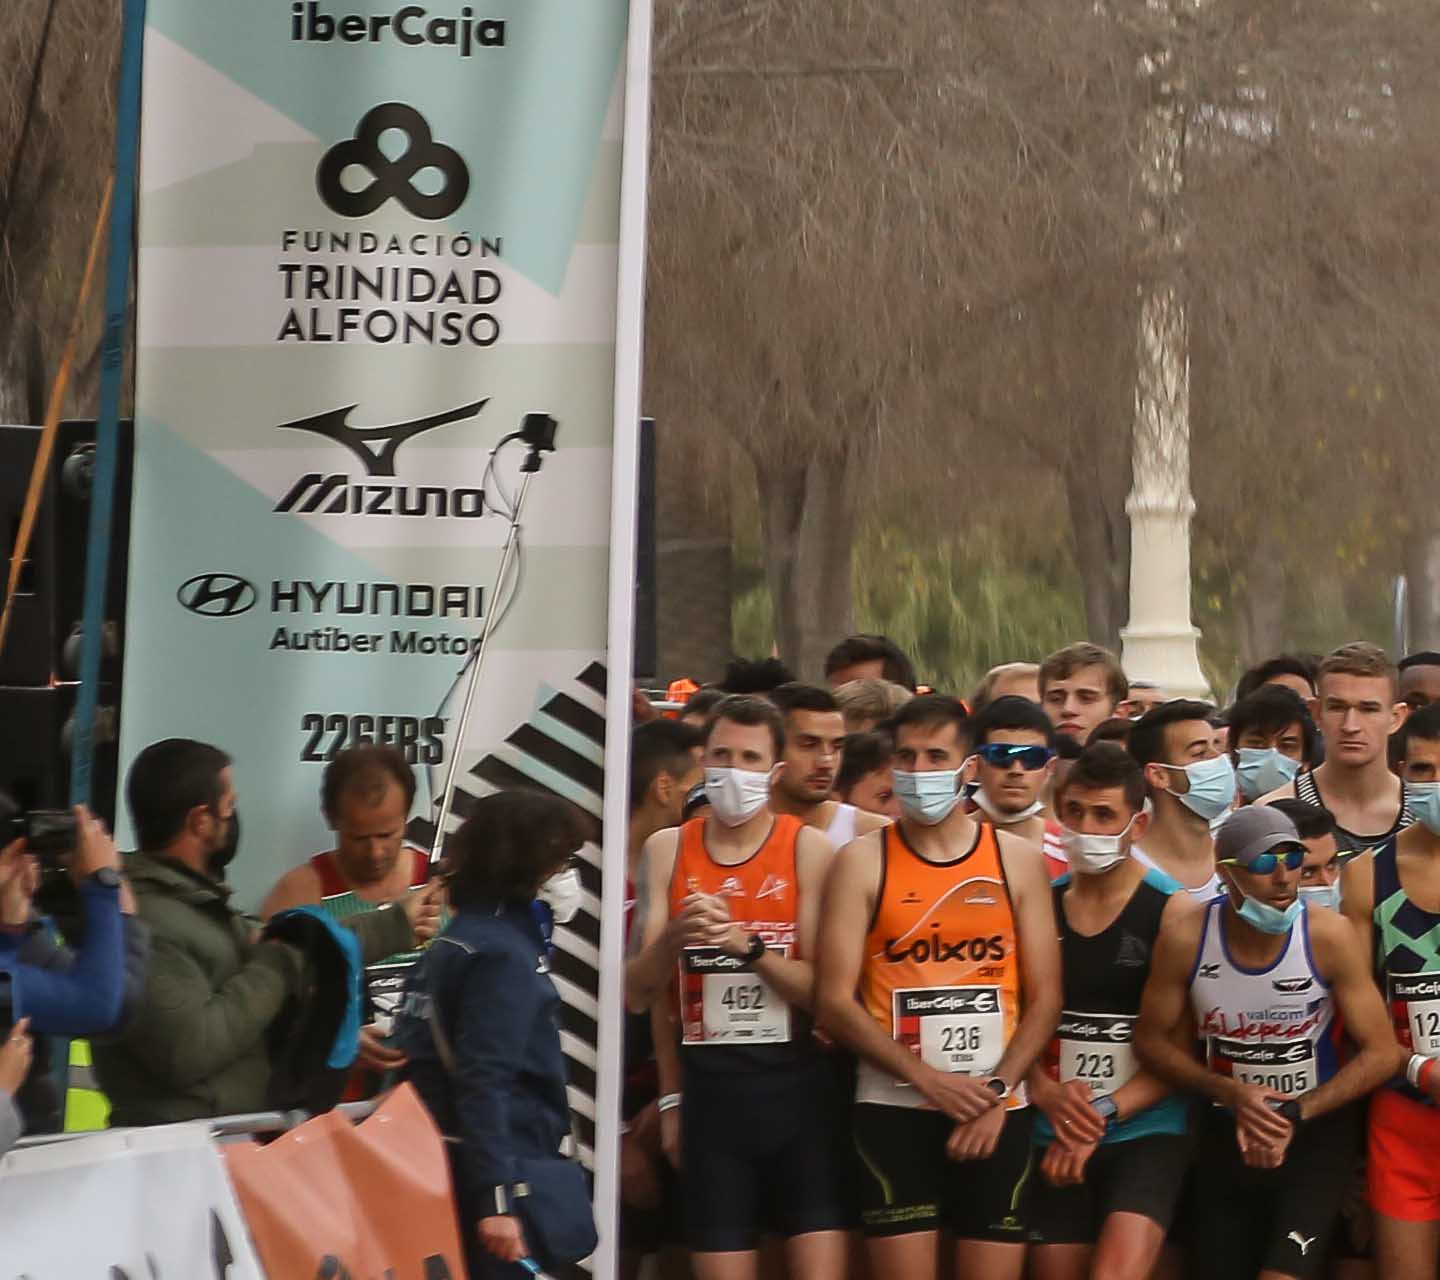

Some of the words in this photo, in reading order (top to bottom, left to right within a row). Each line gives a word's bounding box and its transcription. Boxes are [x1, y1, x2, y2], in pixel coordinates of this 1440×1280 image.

[290, 1, 507, 57] iberCaja
[281, 230, 505, 258] FUNDACIÓN
[278, 263, 502, 305] TRINIDAD
[277, 307, 501, 348] ALFONSO
[271, 581, 485, 618] HYUNDAI
[270, 626, 384, 653] Autiber
[721, 985, 766, 1010] 462
[941, 1025, 981, 1052] 236
[1075, 1052, 1115, 1078] 223
